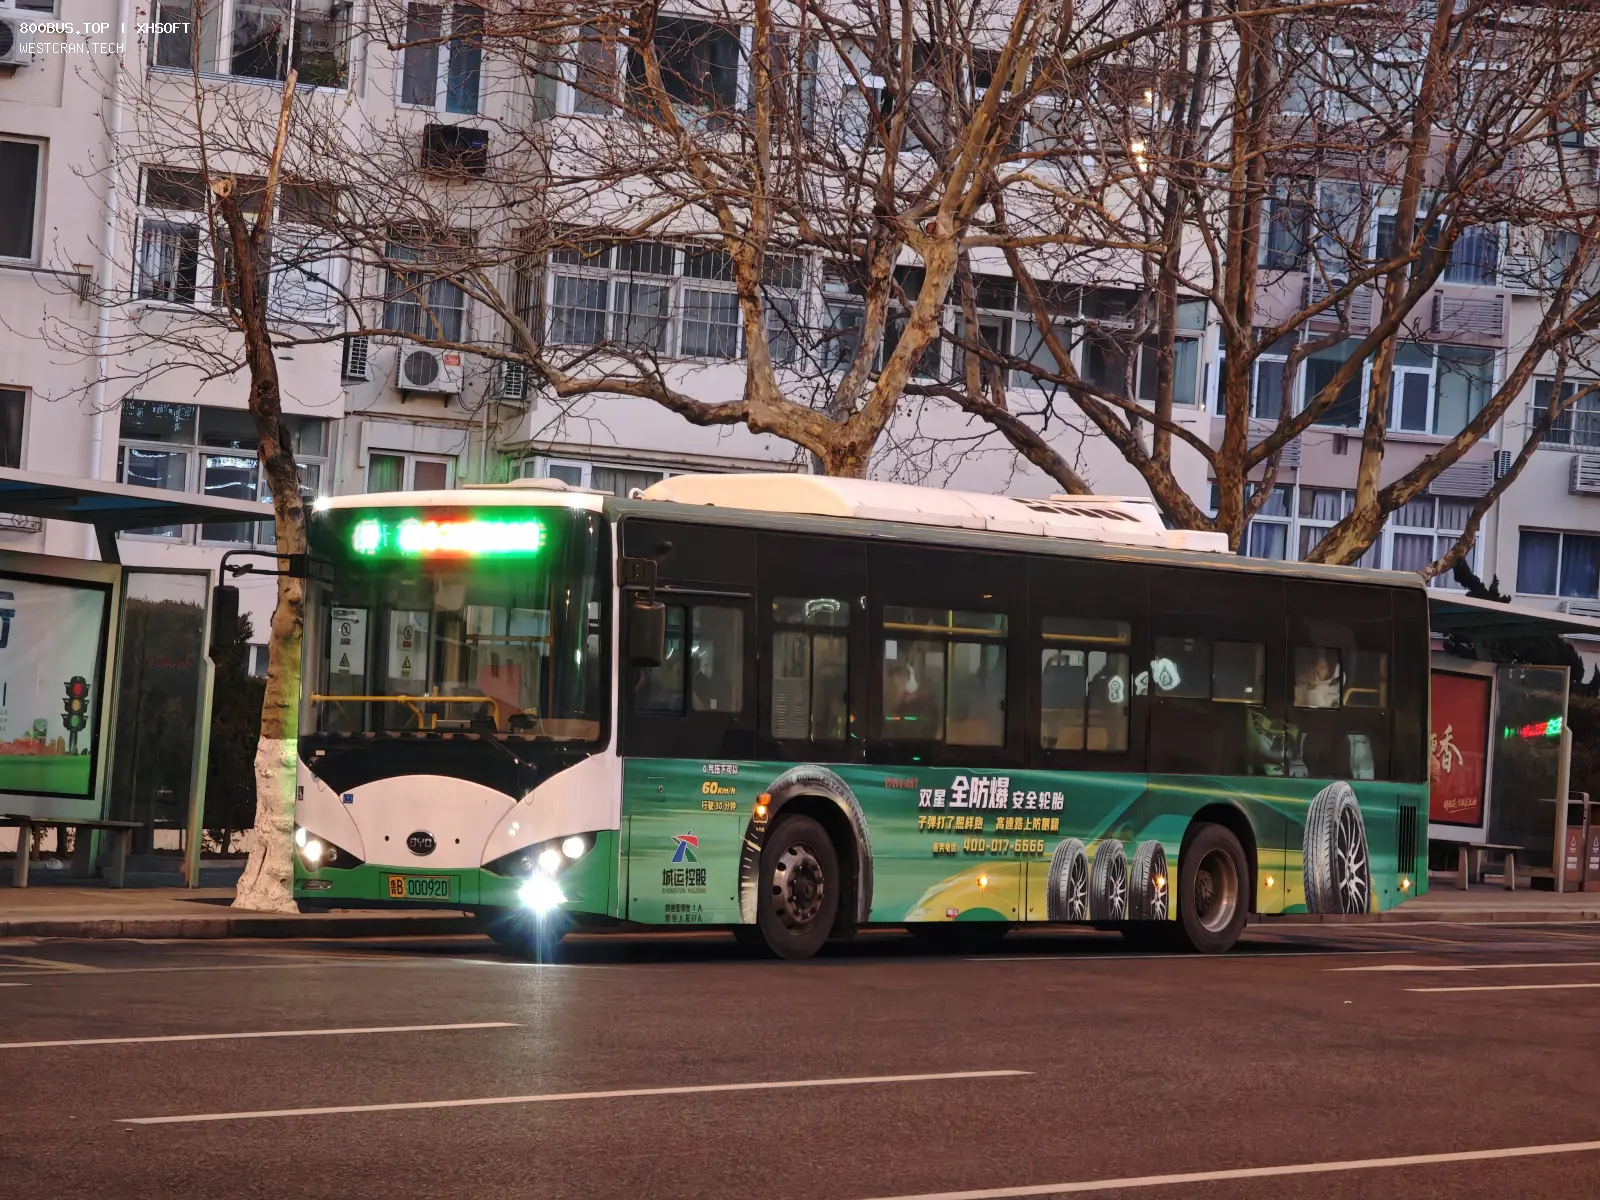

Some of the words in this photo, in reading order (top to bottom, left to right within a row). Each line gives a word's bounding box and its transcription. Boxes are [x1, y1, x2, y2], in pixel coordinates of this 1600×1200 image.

[949, 775, 1010, 810] 全防爆
[1012, 791, 1065, 810] 安全轮胎
[410, 837, 432, 848] BYD
[963, 838, 1045, 852] 400-017-6666
[662, 868, 706, 887] 城运控股
